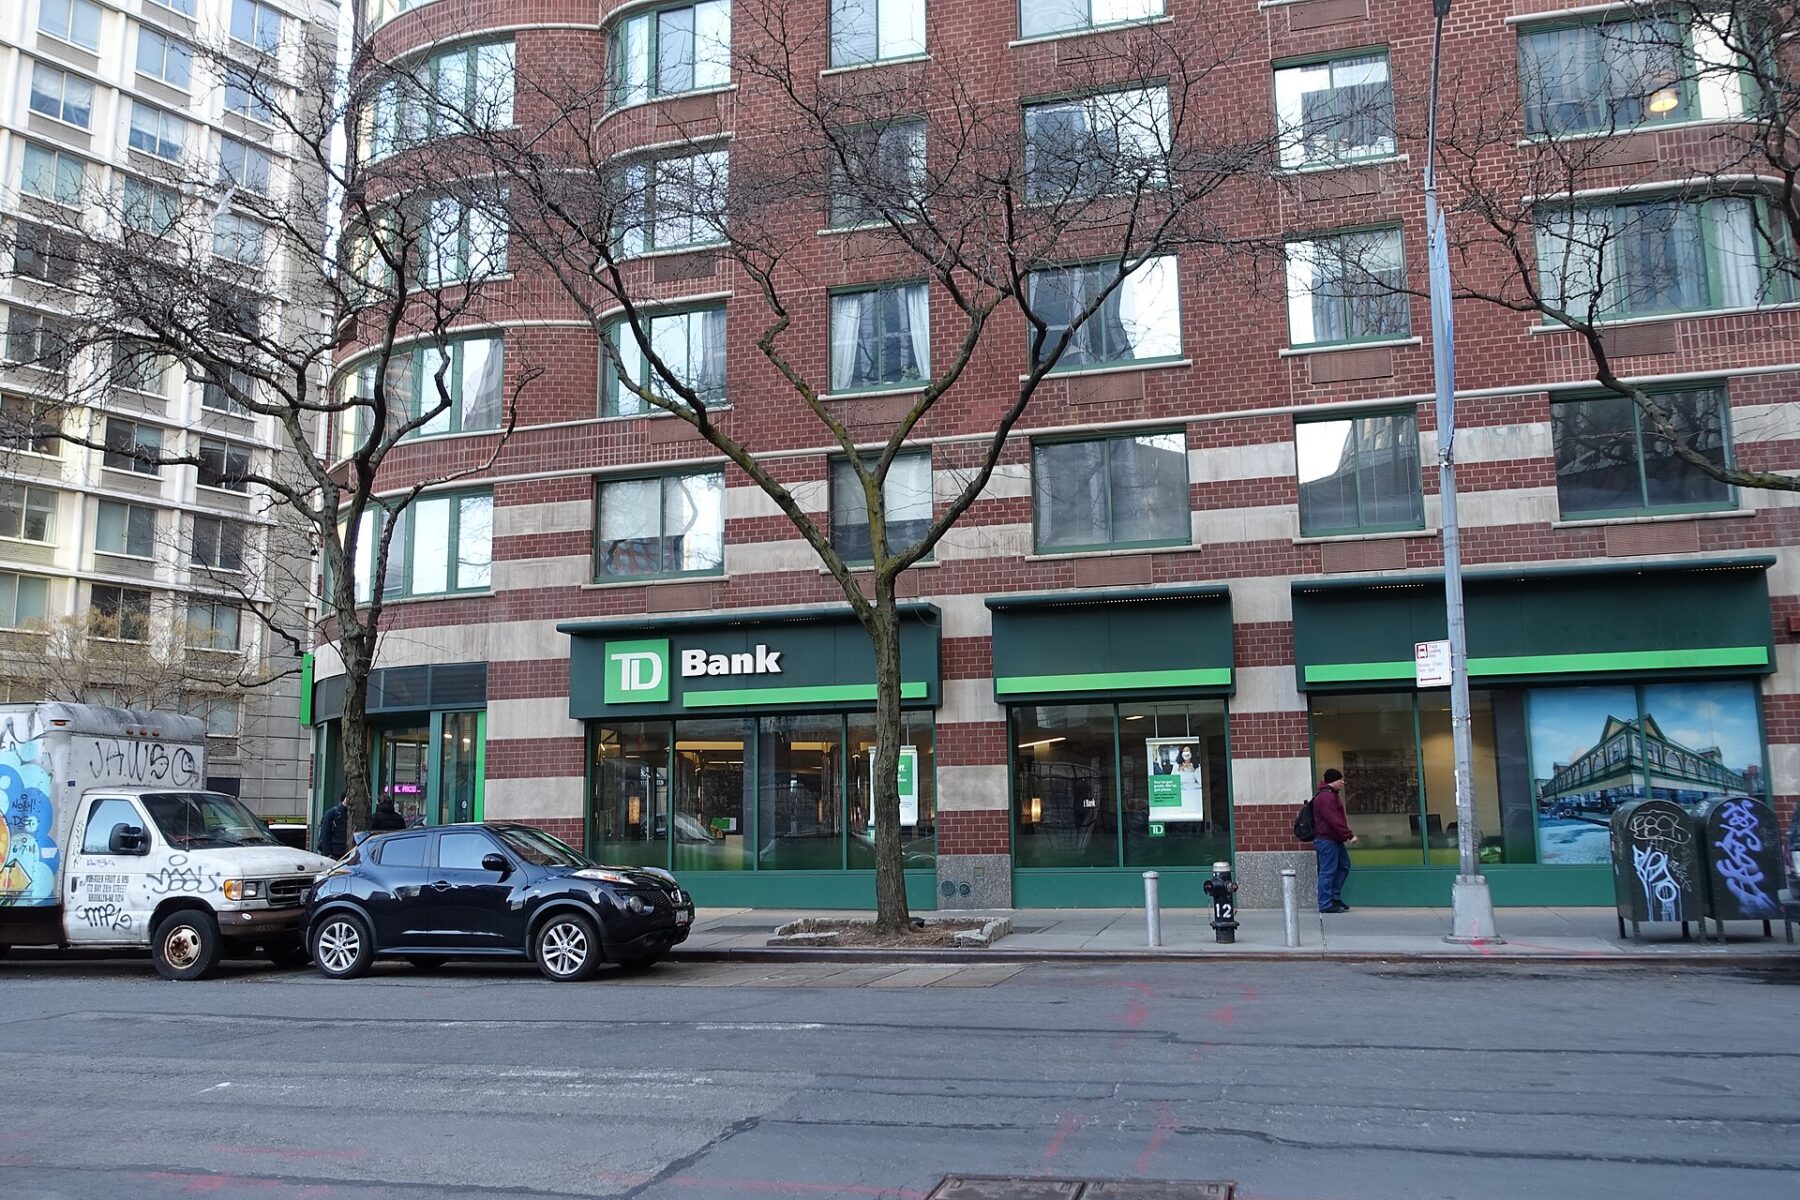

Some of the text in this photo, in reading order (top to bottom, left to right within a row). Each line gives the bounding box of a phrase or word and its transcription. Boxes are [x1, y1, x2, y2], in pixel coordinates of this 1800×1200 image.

[610, 644, 783, 691] TD Bank
[1150, 824, 1164, 834] TD
[1215, 903, 1232, 919] 12
